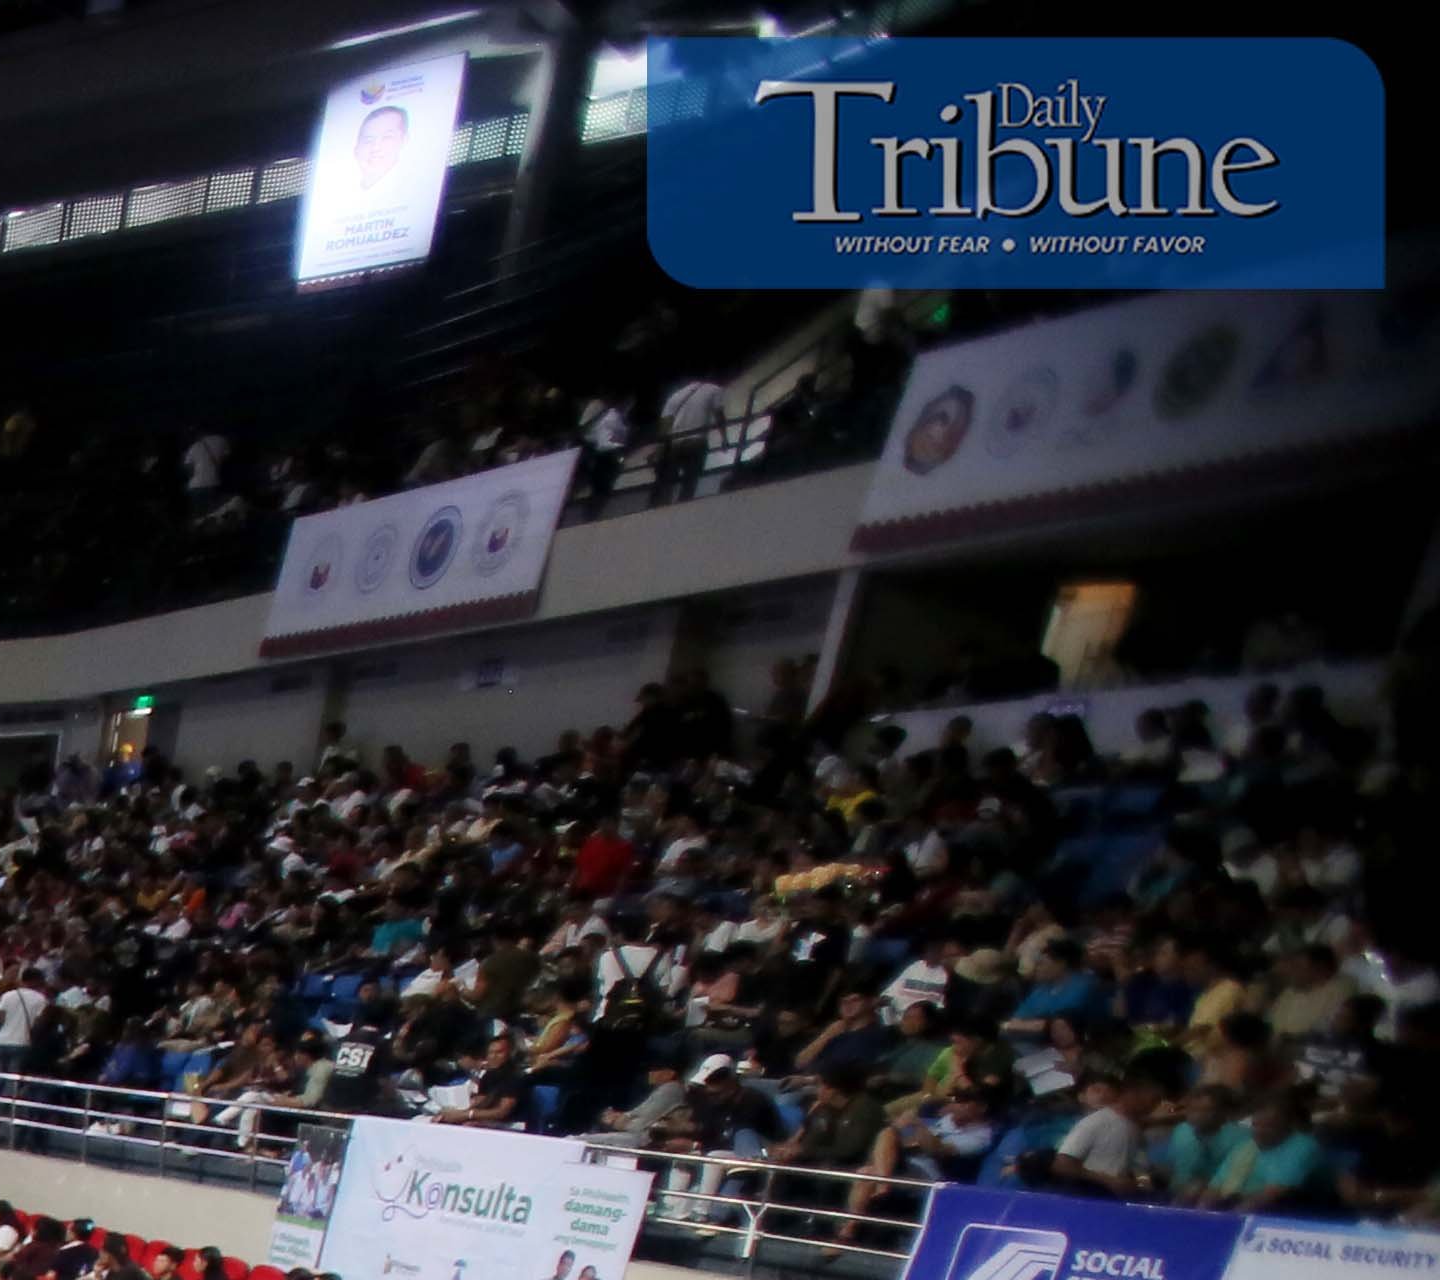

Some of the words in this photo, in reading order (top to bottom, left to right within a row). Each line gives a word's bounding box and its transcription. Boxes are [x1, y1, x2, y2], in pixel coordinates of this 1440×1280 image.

[1071, 1250, 1164, 1280] SOCIAL
[1267, 1238, 1332, 1259] SOCIAL
[1340, 1245, 1437, 1269] SECURITY
